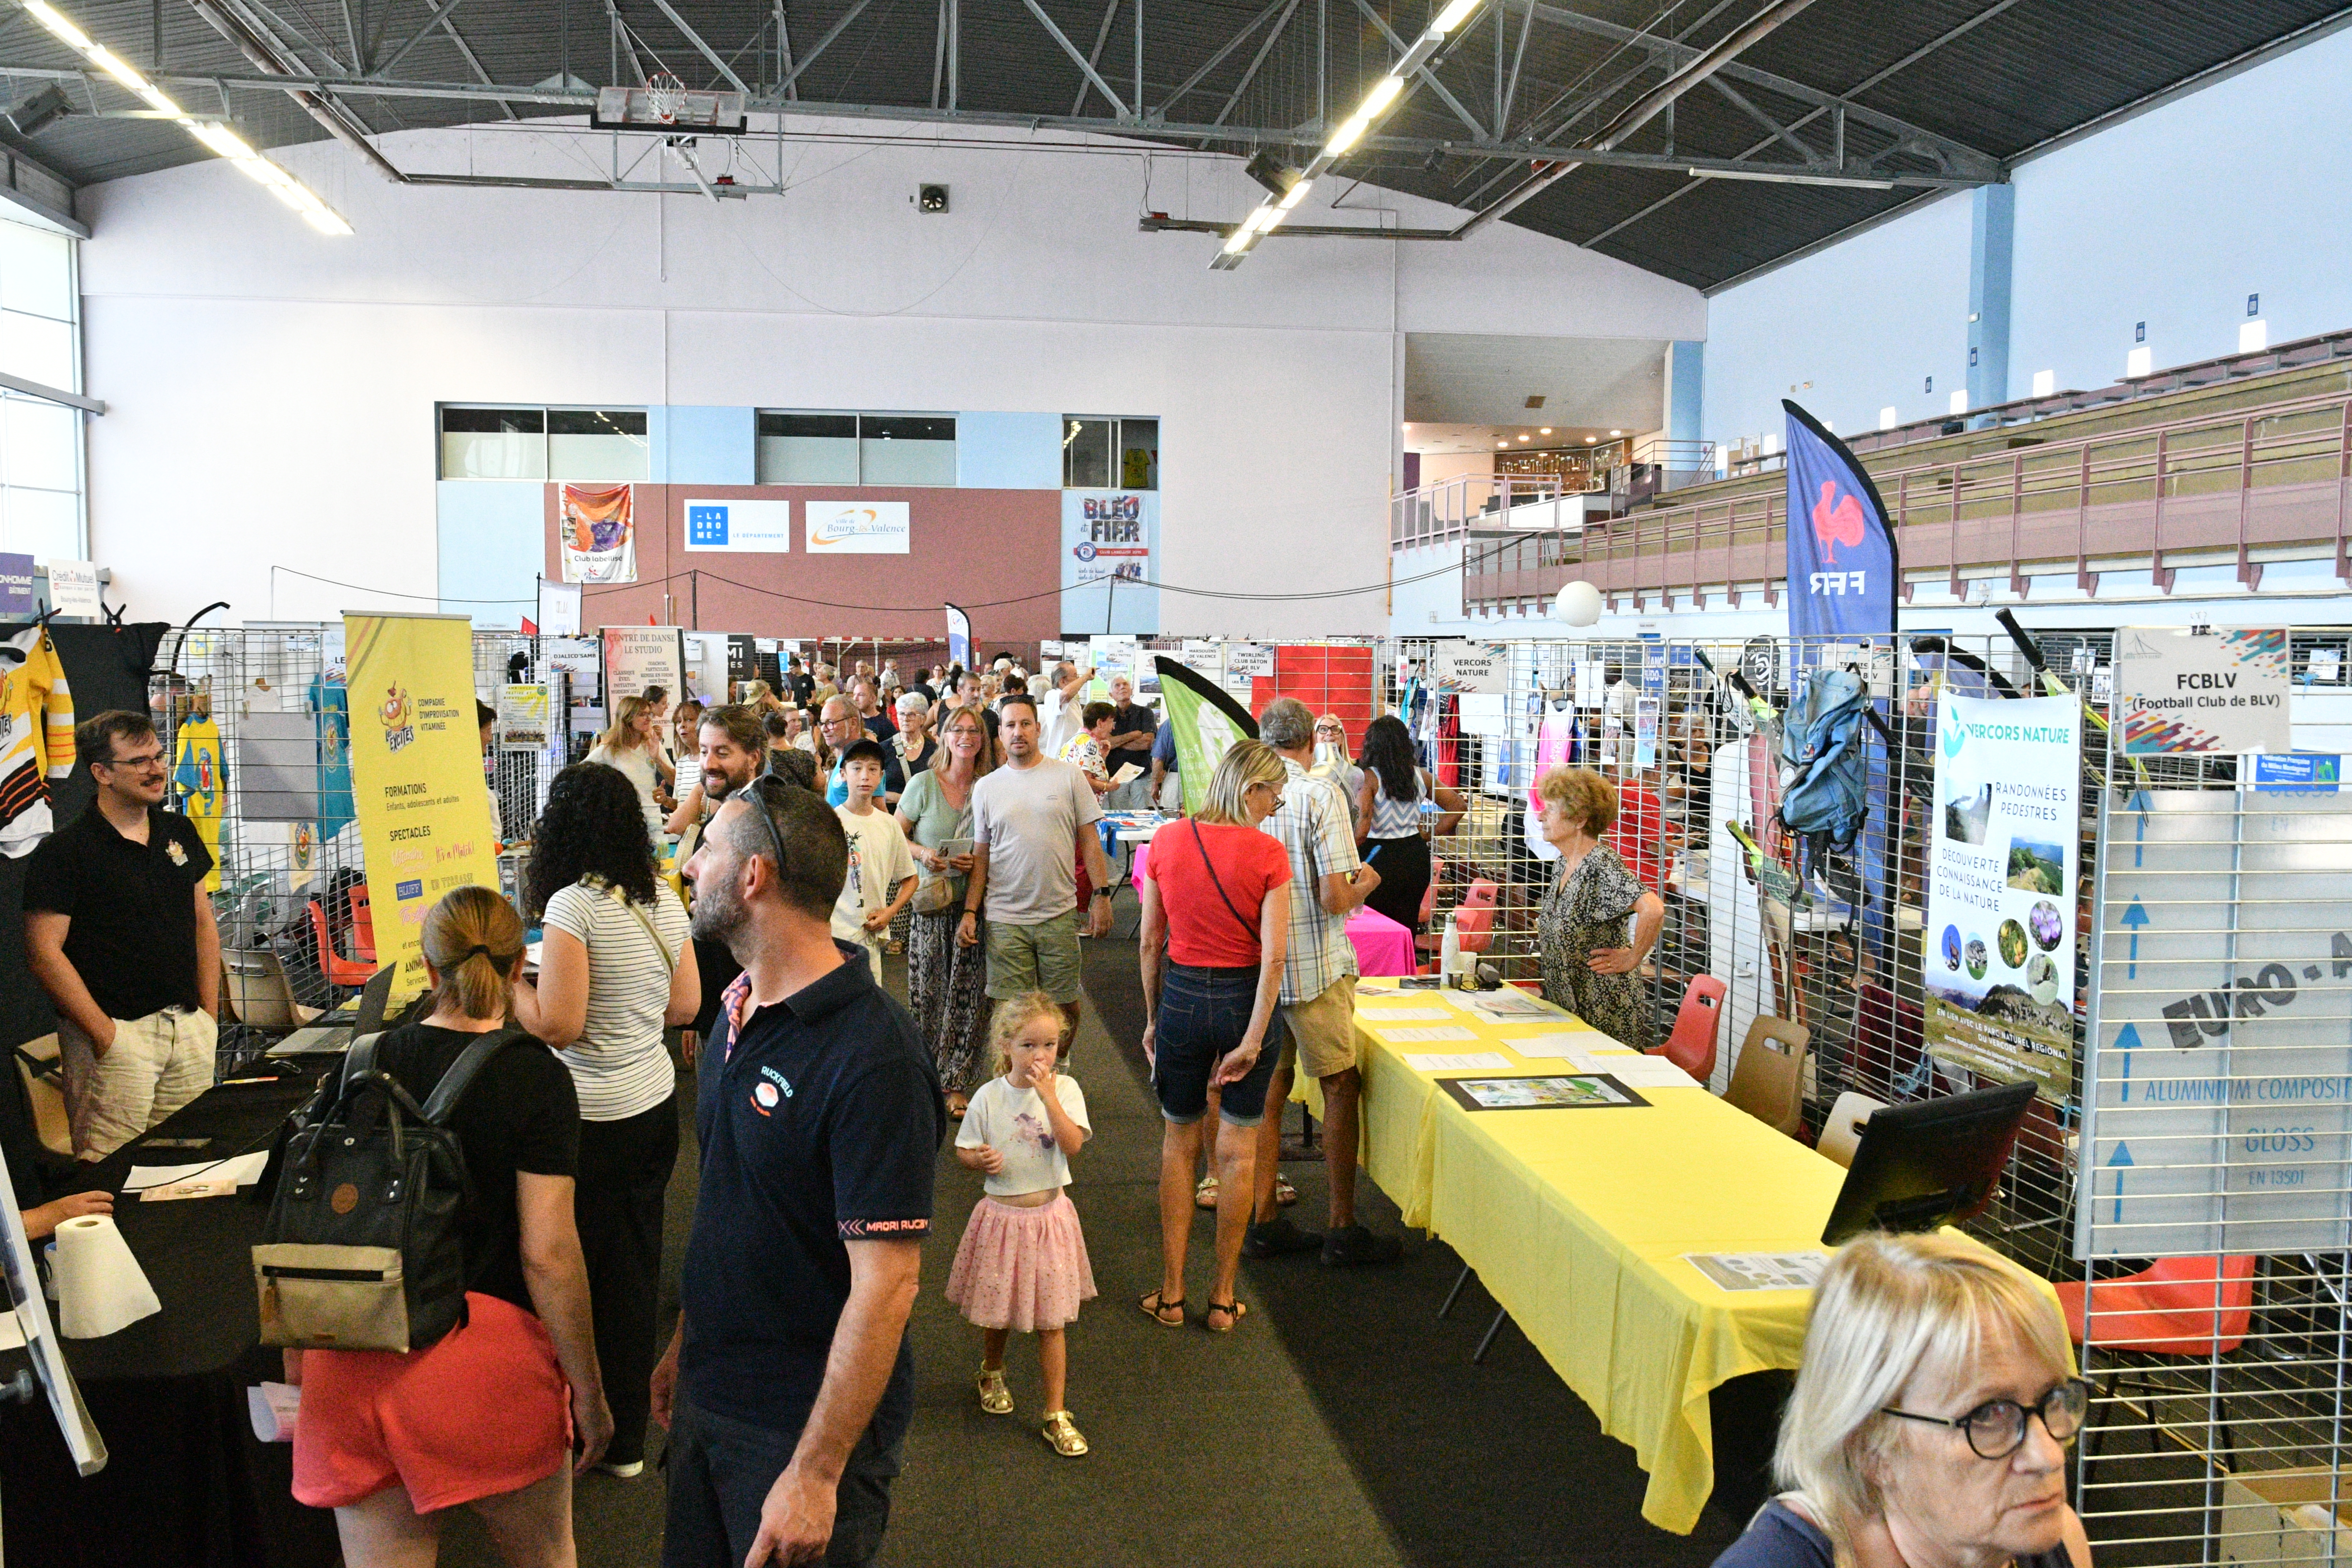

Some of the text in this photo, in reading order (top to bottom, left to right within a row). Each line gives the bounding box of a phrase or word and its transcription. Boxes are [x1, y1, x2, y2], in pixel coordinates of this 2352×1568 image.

[1084, 497, 1139, 520] BLEU
[1081, 520, 1140, 542] et FIER
[52, 570, 95, 583] Crédit Mutuel
[2177, 672, 2237, 690] FCBLV
[418, 698, 445, 707] COMPAGNIE
[2132, 694, 2281, 711] (Football Club de BLV)
[419, 709, 459, 719] D'IMPROVISATION
[420, 720, 446, 731] VITAMINÉE
[1965, 724, 2069, 744] VERCORS NATURE
[385, 783, 427, 798] FORMATIONS
[1995, 781, 2066, 802] RANDONNÉES
[387, 803, 406, 811] Enfants,
[407, 798, 436, 809] adolescents
[444, 795, 460, 803] adultes
[2001, 802, 2057, 821] PEDESTRES
[389, 825, 431, 841] SPECTACLES
[1943, 847, 1999, 873] DÉCOUVERTE
[1937, 865, 2003, 893] CONNAISSANCE
[398, 883, 420, 897] BLUFF
[1939, 884, 1999, 912] DE LA NATURE
[403, 942, 407, 950] et
[406, 975, 427, 986] Services
[1937, 1008, 2067, 1061] EN LIEN AVEC LE PARC NATUREL REGIONAL
[1978, 1034, 2017, 1054] DU VERCORS
[762, 1065, 793, 1098] RUCKFIELD
[2145, 1079, 2251, 1101] ALUMINIUM
[2246, 1127, 2314, 1153] GLOSS
[2249, 1171, 2265, 1185] EN
[866, 1221, 899, 1232] MAORI
